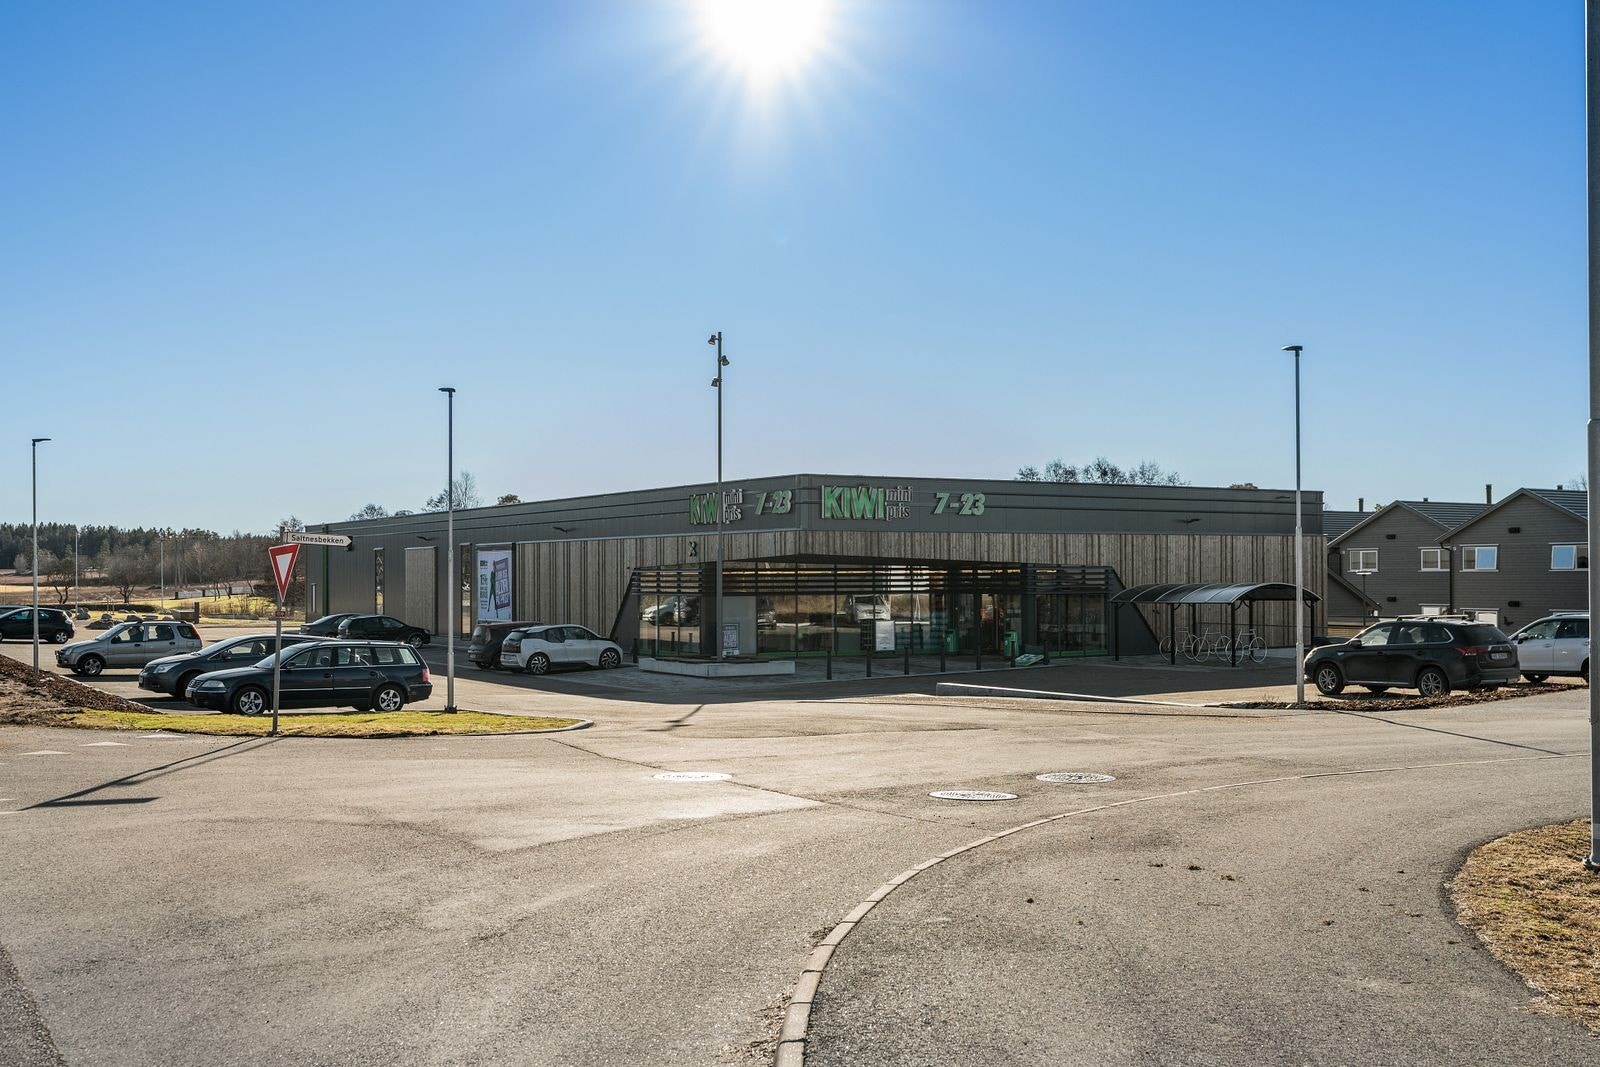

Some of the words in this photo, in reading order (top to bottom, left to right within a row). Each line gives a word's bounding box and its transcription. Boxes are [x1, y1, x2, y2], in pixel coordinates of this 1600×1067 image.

[754, 489, 793, 516] 7-23
[821, 484, 885, 520] KIWI
[885, 484, 913, 502] mini
[933, 492, 987, 516] 7-23
[885, 501, 911, 521] pris
[291, 534, 344, 544] Saltnesbekken
